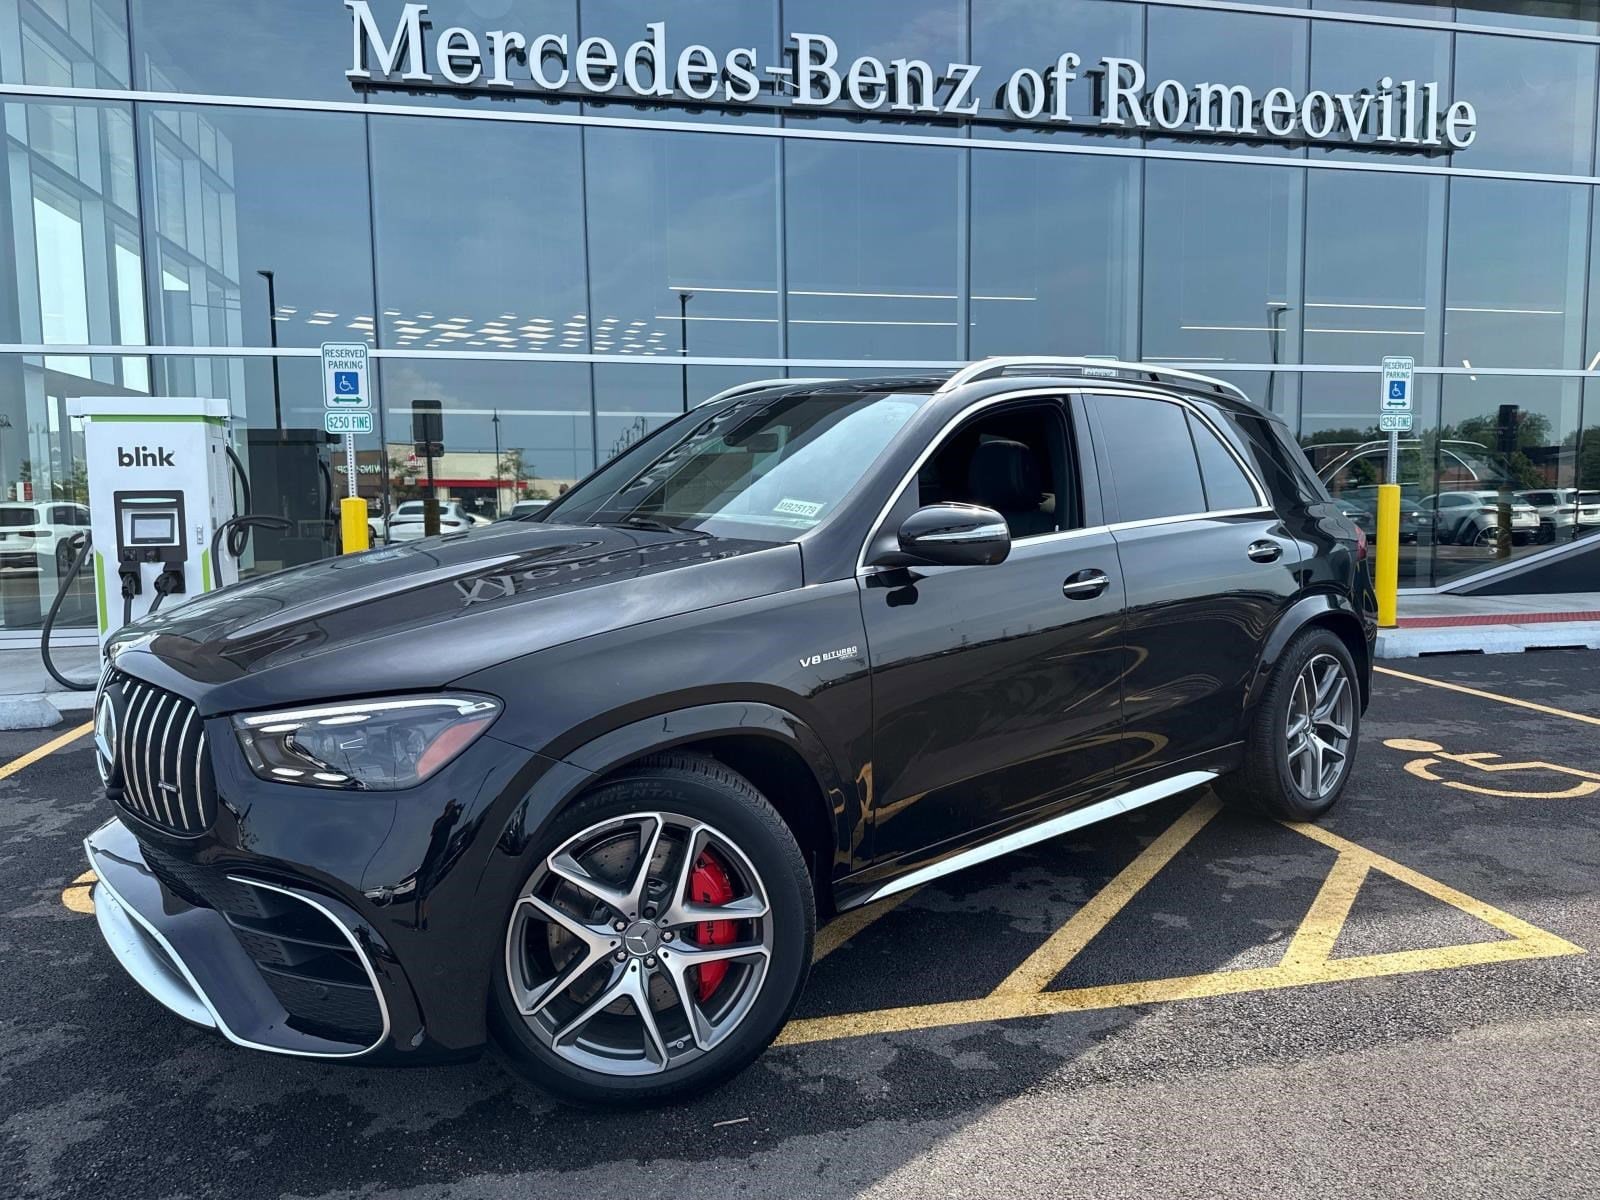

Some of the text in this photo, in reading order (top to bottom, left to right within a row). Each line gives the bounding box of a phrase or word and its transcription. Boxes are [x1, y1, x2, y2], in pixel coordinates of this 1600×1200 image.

[344, 0, 1477, 149] Mercedes-Benz of Romeoville
[324, 349, 365, 358] RESERVED
[328, 361, 363, 370] PARKING
[1384, 362, 1412, 370] RESERVED
[1386, 371, 1410, 379] PARKING
[328, 416, 370, 429] $250 FINE
[1382, 416, 1410, 427] $250 FINE
[117, 446, 175, 467] blink
[799, 655, 821, 667] V8
[822, 645, 858, 661] BITURBO
